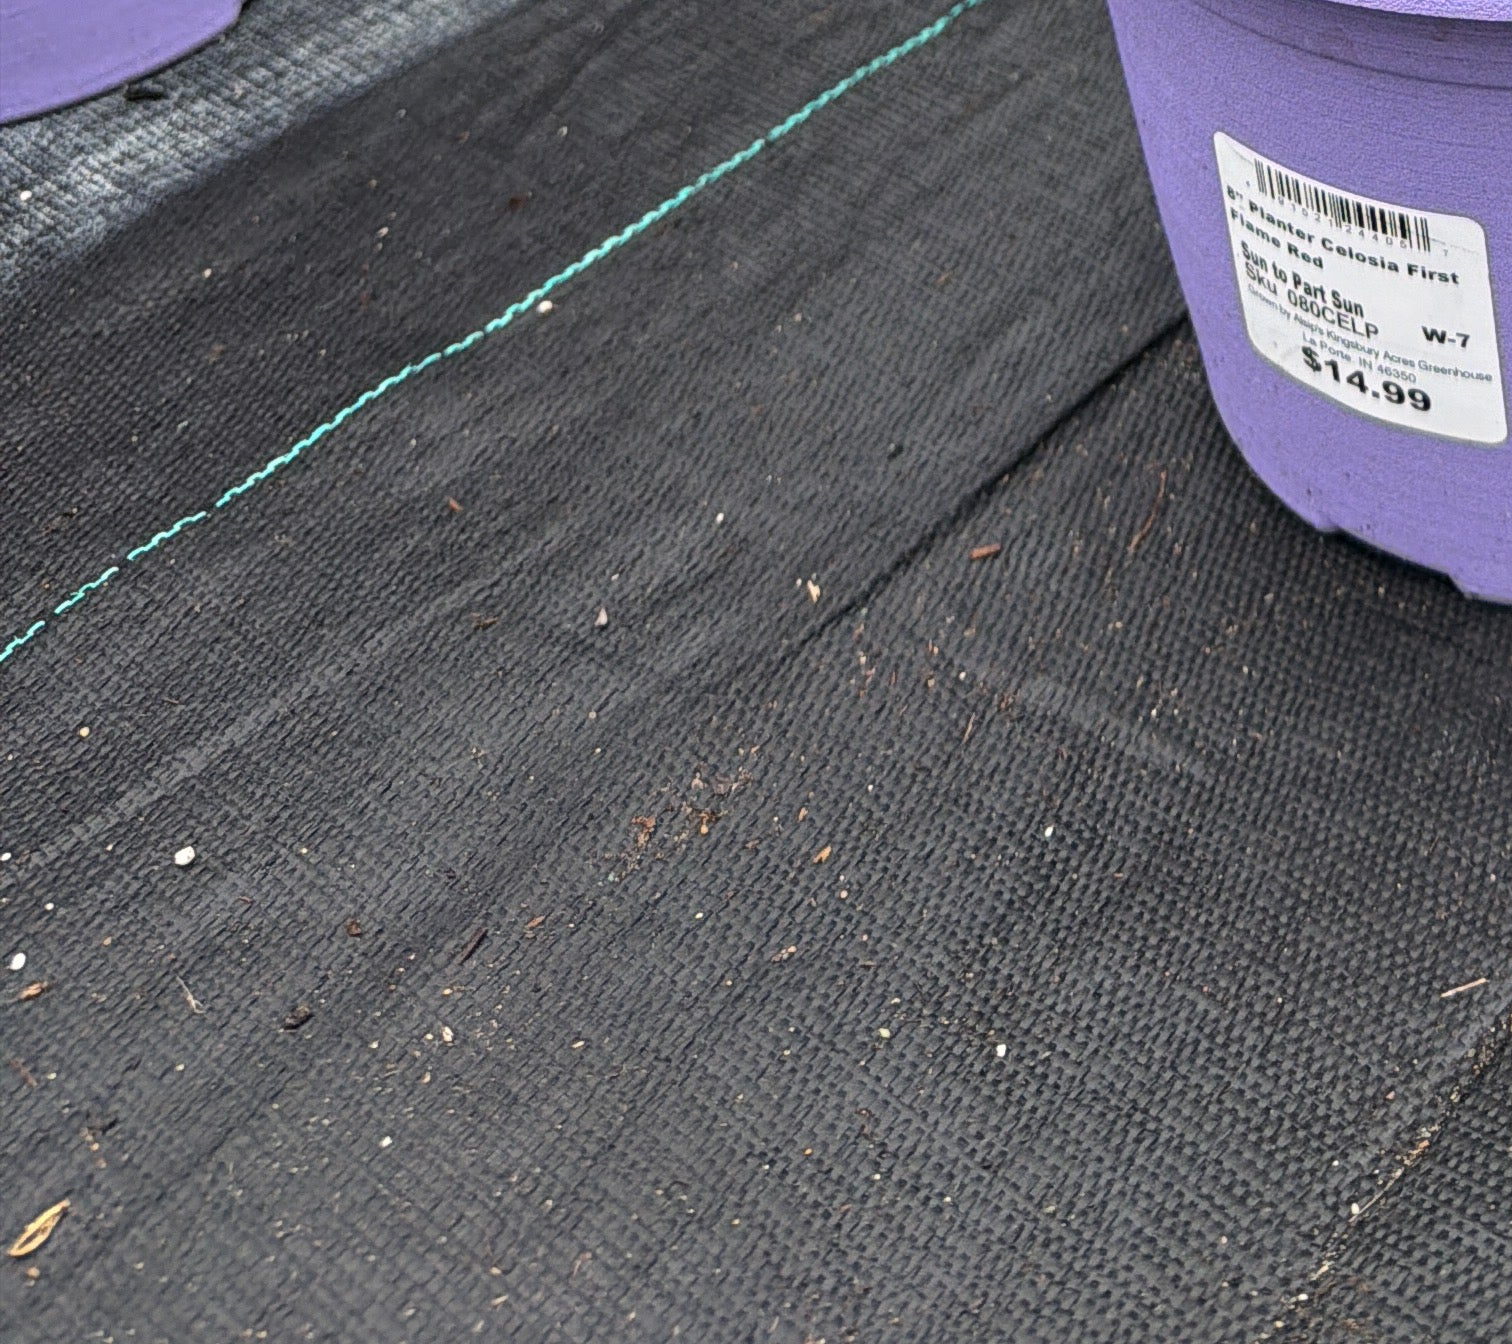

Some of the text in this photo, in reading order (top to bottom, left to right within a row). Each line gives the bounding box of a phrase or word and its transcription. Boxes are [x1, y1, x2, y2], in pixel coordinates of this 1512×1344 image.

[1230, 207, 1323, 269] Flame Red
[1249, 199, 1315, 243] Planter
[1321, 237, 1399, 272] Celosia
[1407, 263, 1459, 284] First
[1241, 240, 1364, 318] Sun to Part Sun
[1245, 261, 1277, 296] Sku
[1302, 330, 1317, 347] La
[1359, 356, 1373, 371] IN
[1377, 364, 1417, 384] 46350
[1327, 328, 1380, 360] Kingsbury
[1383, 350, 1416, 368] Acres
[1418, 359, 1493, 382] Greenhouse
[1421, 326, 1471, 348] W-7
[1301, 345, 1432, 412] $14.99
